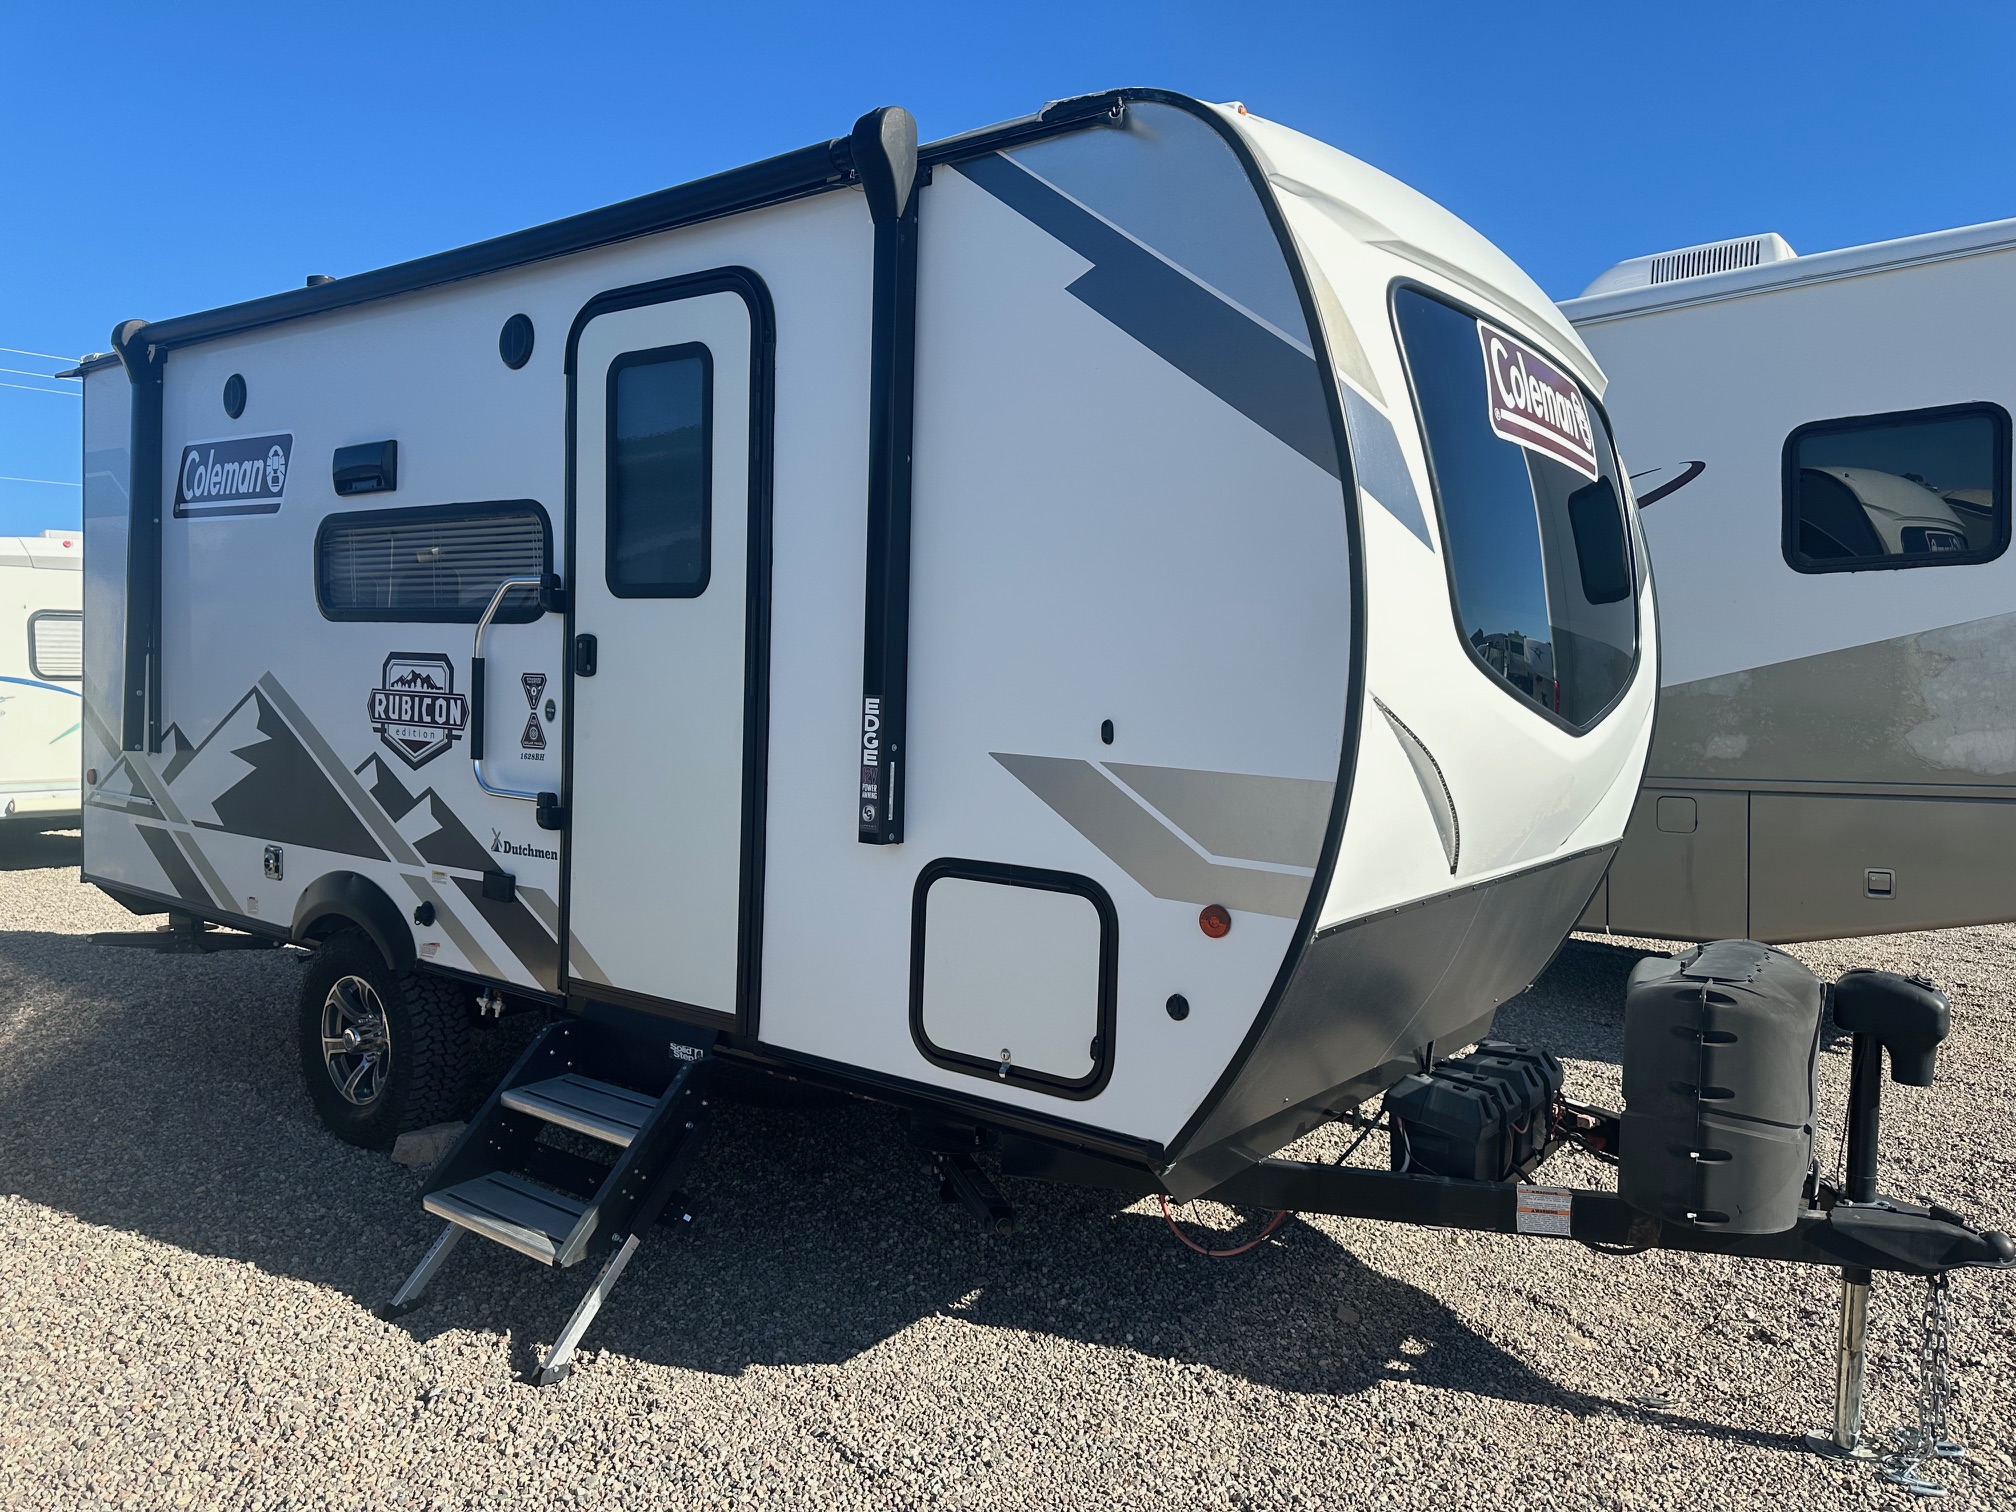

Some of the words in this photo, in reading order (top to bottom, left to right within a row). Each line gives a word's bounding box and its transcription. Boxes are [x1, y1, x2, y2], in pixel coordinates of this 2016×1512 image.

[1490, 337, 1580, 441] Coleman
[183, 449, 264, 501] Coleman
[374, 693, 462, 725] RUBICON
[396, 728, 434, 739] edition
[863, 698, 880, 766] EDGE
[520, 752, 545, 761] 1628BH
[862, 784, 878, 792] POWER
[504, 840, 558, 860] Dutchmen
[670, 1042, 692, 1054] Solid
[674, 1050, 694, 1062] Step
